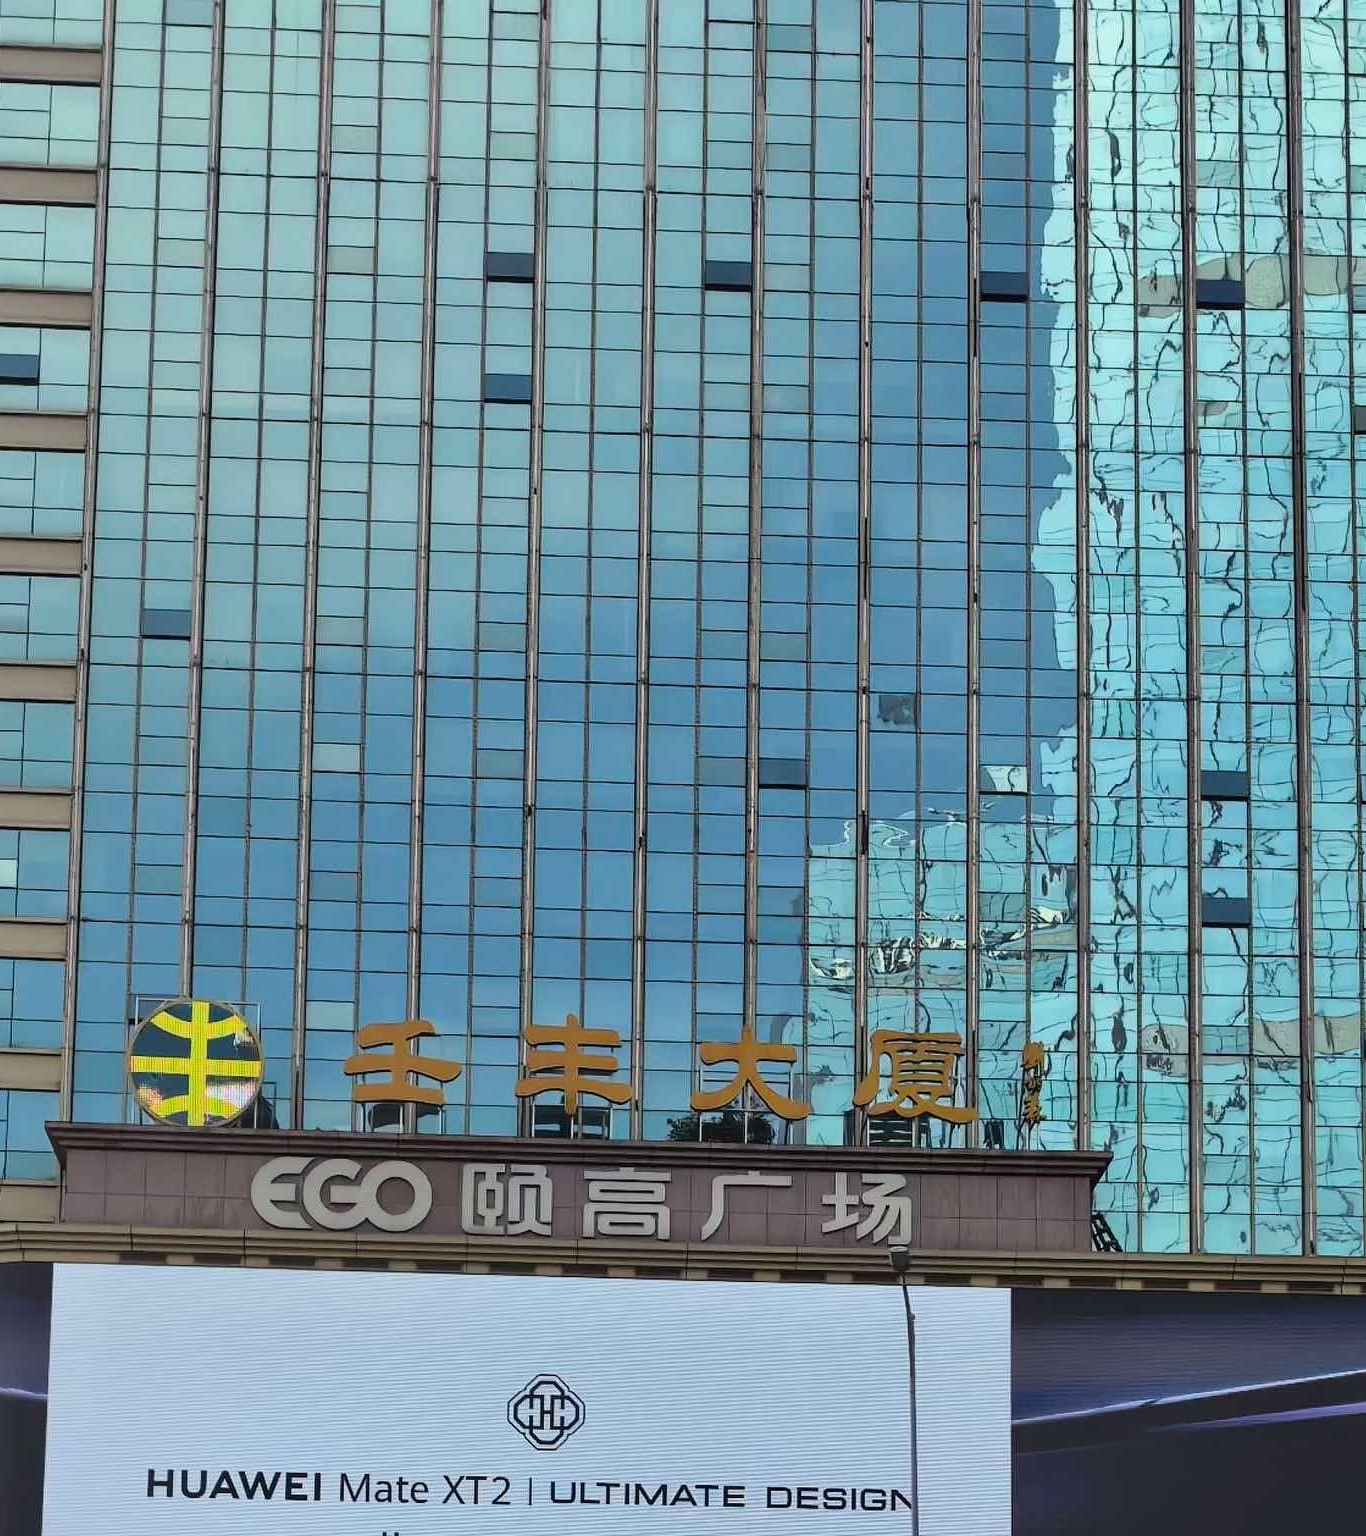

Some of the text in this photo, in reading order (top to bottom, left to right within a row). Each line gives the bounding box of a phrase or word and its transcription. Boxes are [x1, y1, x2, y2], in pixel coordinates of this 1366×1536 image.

[344, 1014, 979, 1125] 壬丰大厦
[250, 1156, 913, 1246] EGO 颐高广场
[146, 1468, 913, 1512] HUAWEI Mate XT2 ULTIMATE DESIGN
